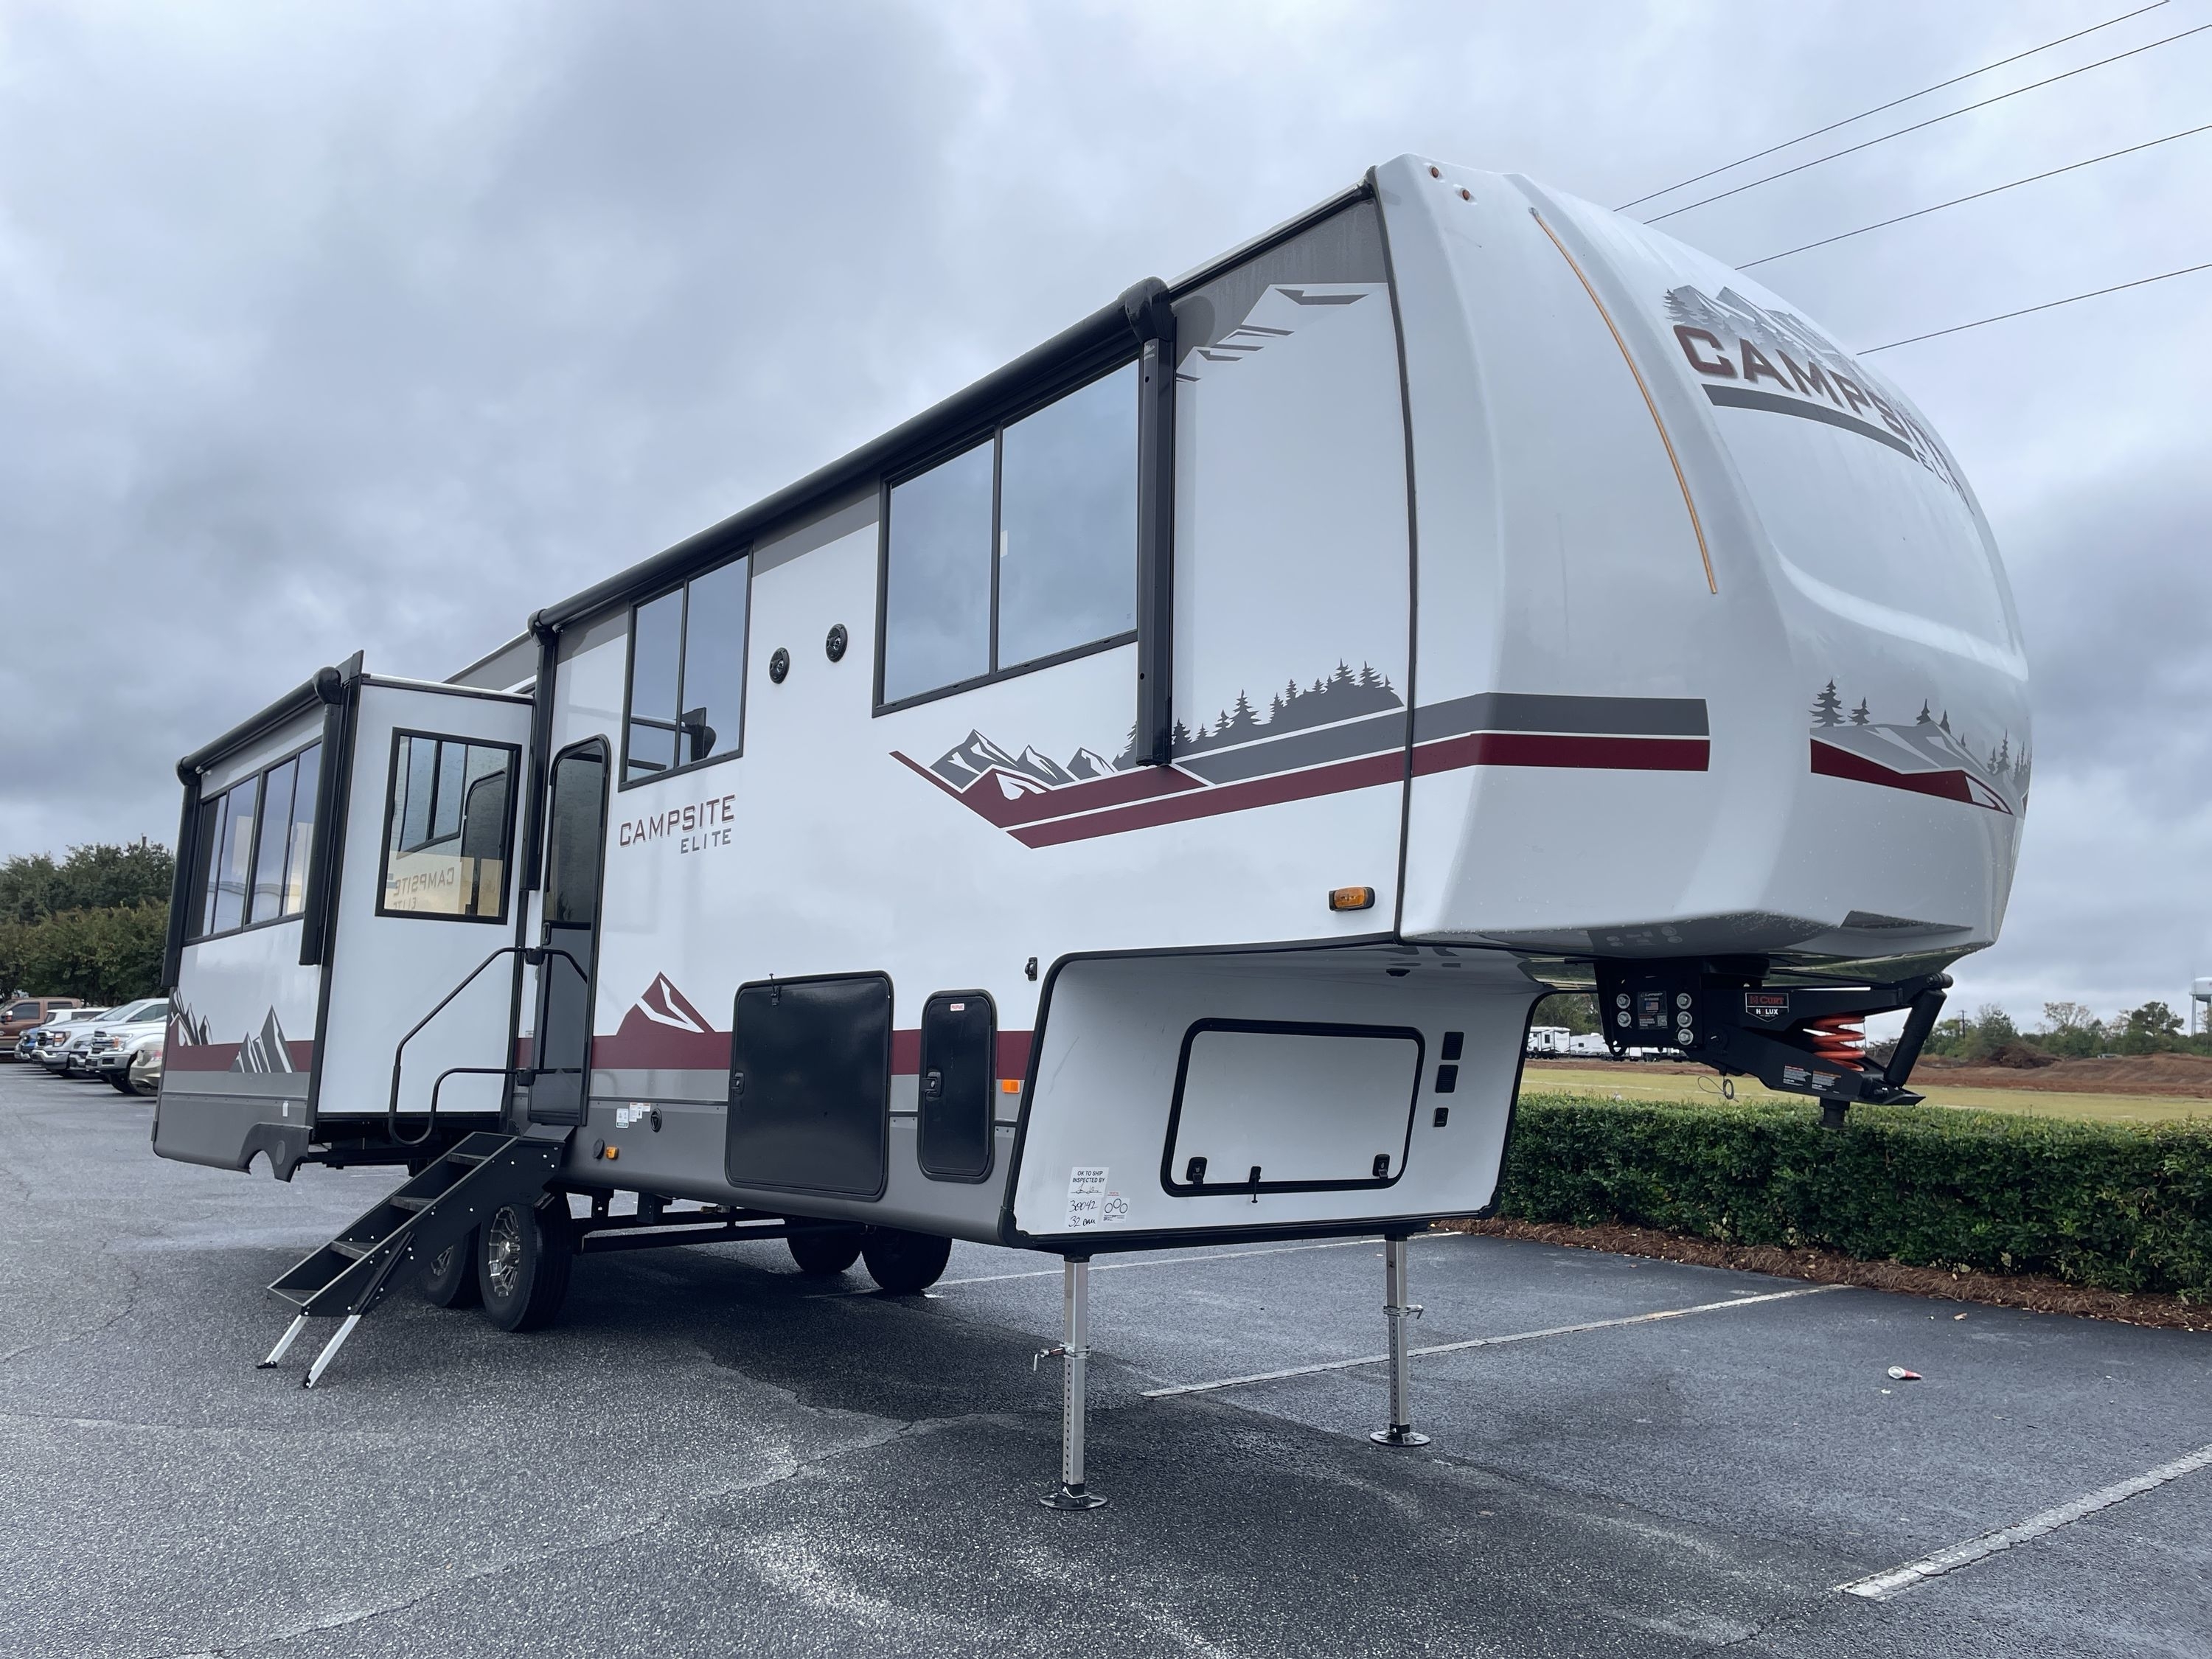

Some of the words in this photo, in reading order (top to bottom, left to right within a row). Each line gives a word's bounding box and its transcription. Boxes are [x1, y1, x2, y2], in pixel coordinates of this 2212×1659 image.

[620, 794, 735, 846] CAMPSITE
[681, 828, 731, 854] ELITE
[1068, 1215, 1081, 1228] 32
